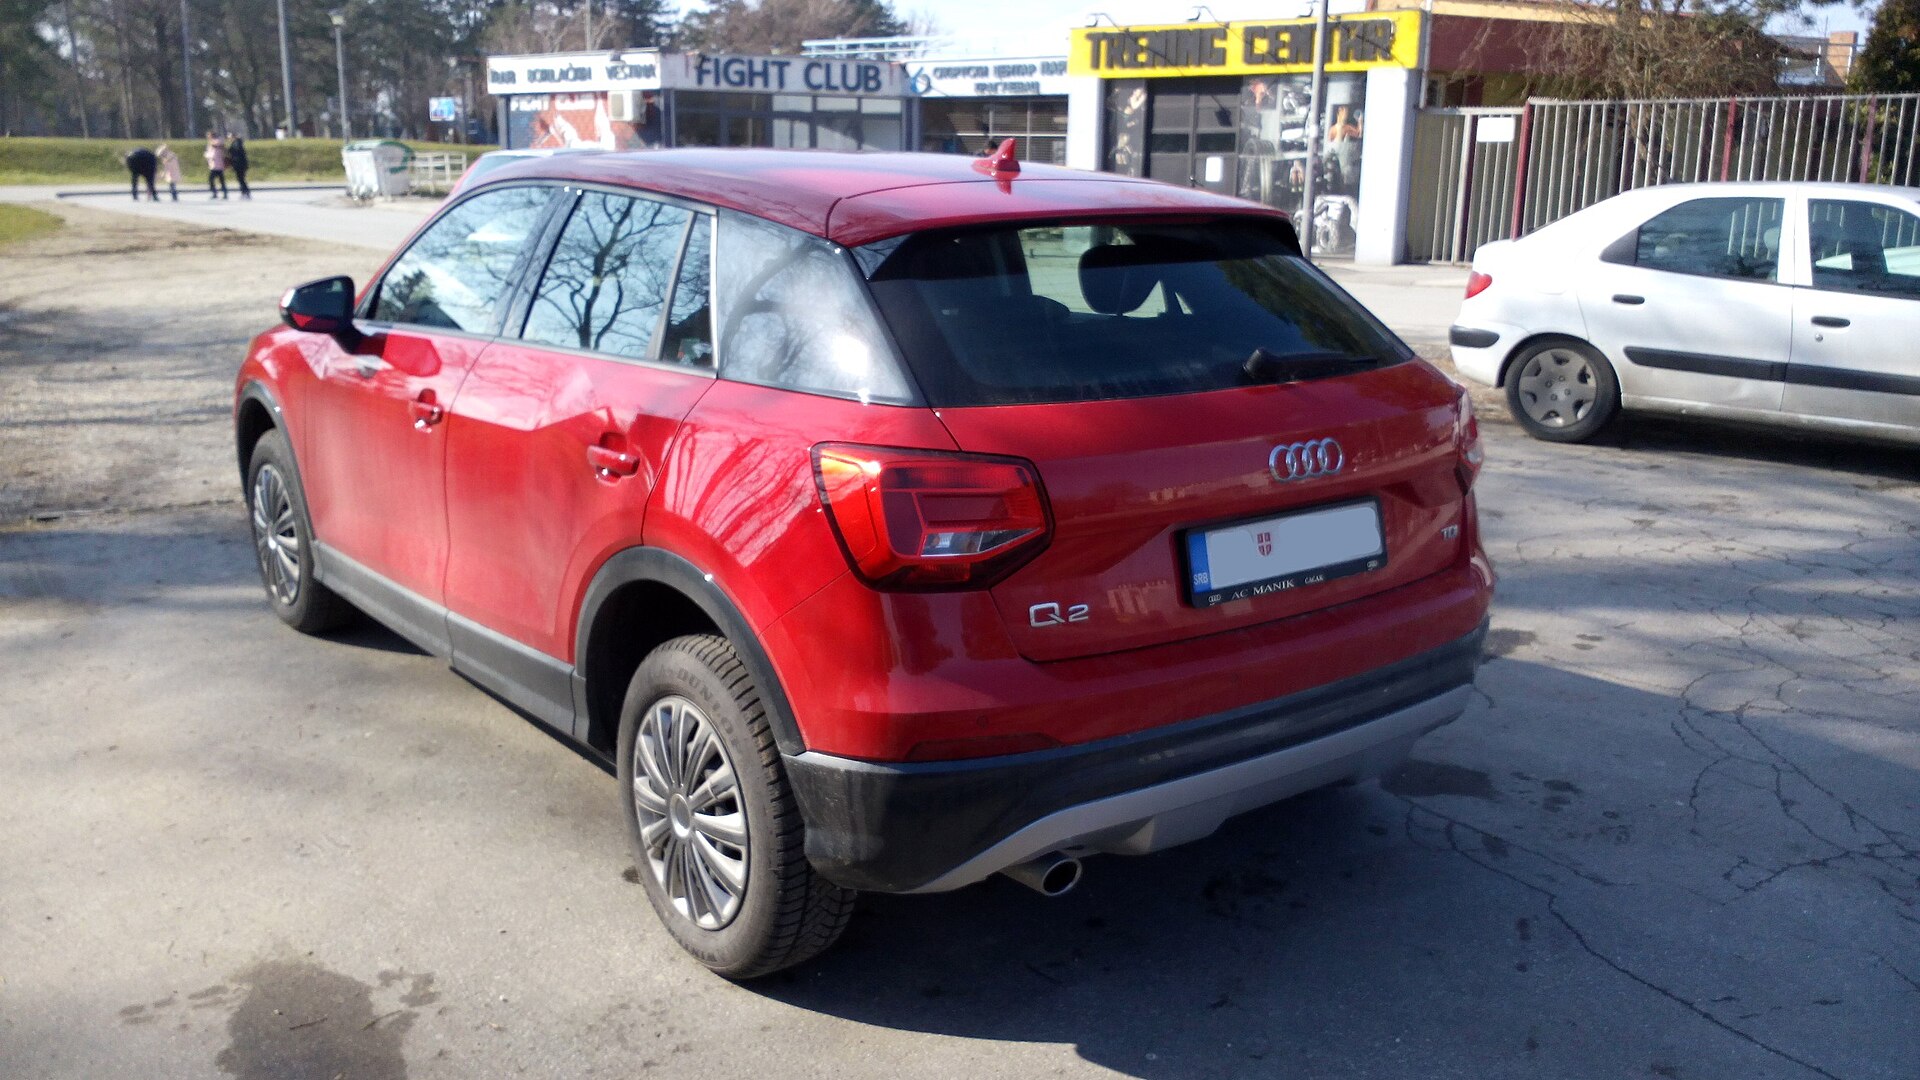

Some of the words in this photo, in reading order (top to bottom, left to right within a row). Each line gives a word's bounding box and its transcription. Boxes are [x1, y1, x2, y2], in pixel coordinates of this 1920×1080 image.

[1086, 28, 1228, 69] TRENING
[696, 57, 790, 89] FIGHT
[803, 62, 881, 92] CLUB
[1193, 572, 1209, 585] SRB
[1231, 589, 1249, 600] AC
[1253, 579, 1295, 595] MANIK
